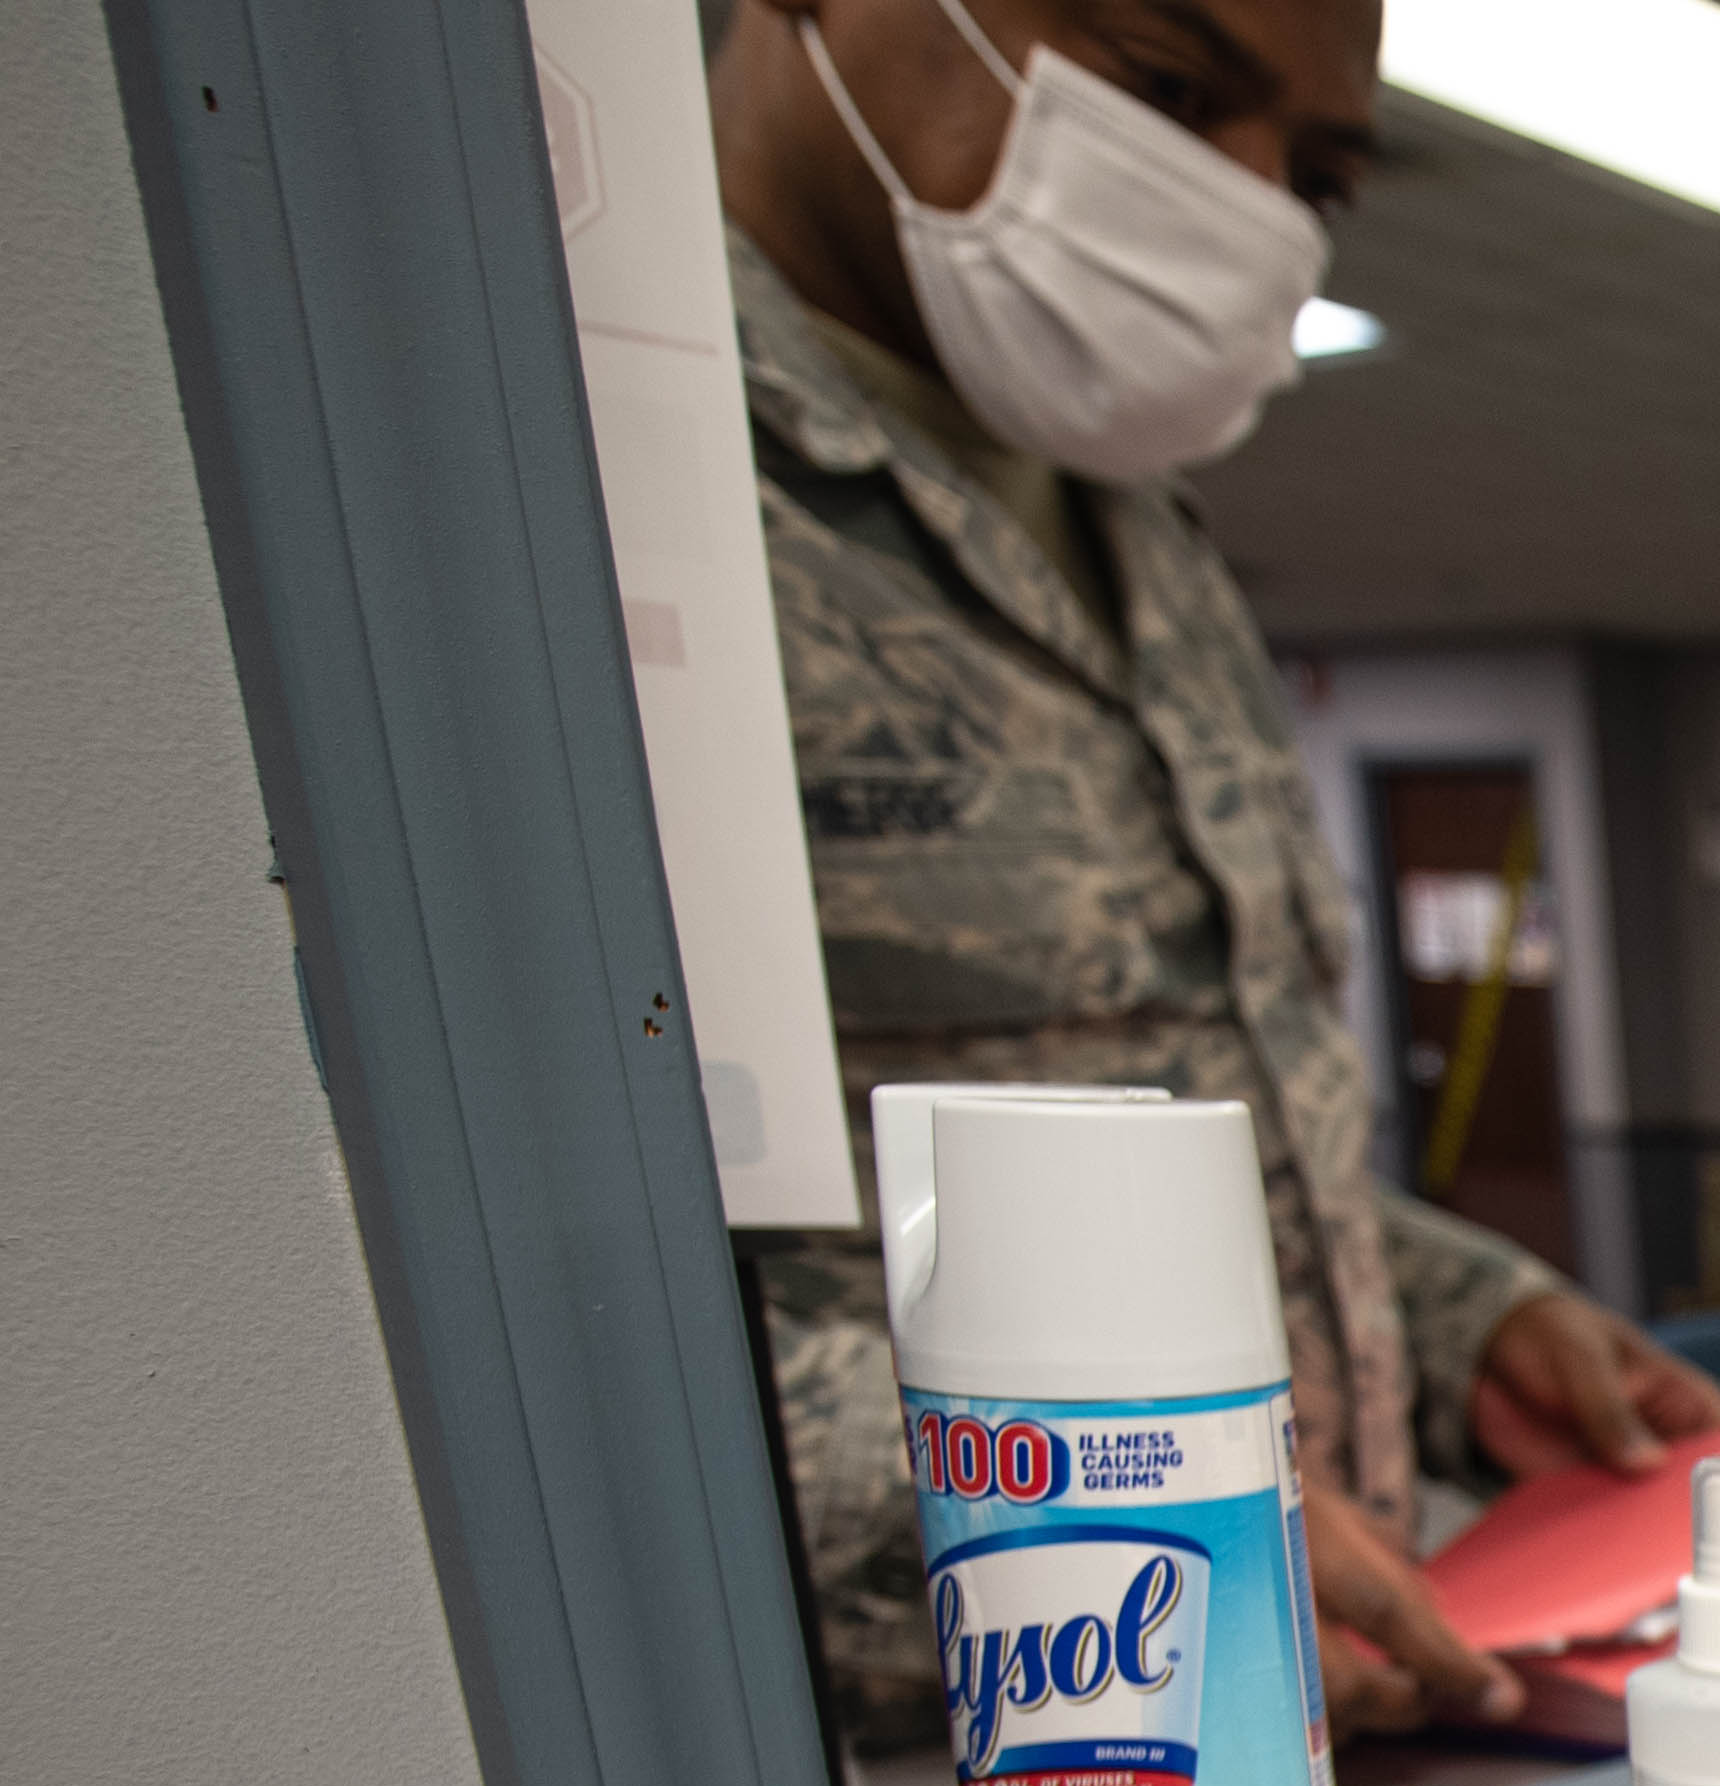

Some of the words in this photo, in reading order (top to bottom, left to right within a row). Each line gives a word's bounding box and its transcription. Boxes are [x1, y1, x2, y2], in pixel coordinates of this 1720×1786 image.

[917, 1410, 1062, 1504] 100
[1079, 1431, 1175, 1453] ILLNESS
[1081, 1449, 1184, 1470] CAUSING
[1084, 1470, 1164, 1491] GERMS
[1095, 1746, 1147, 1761] BRAND
